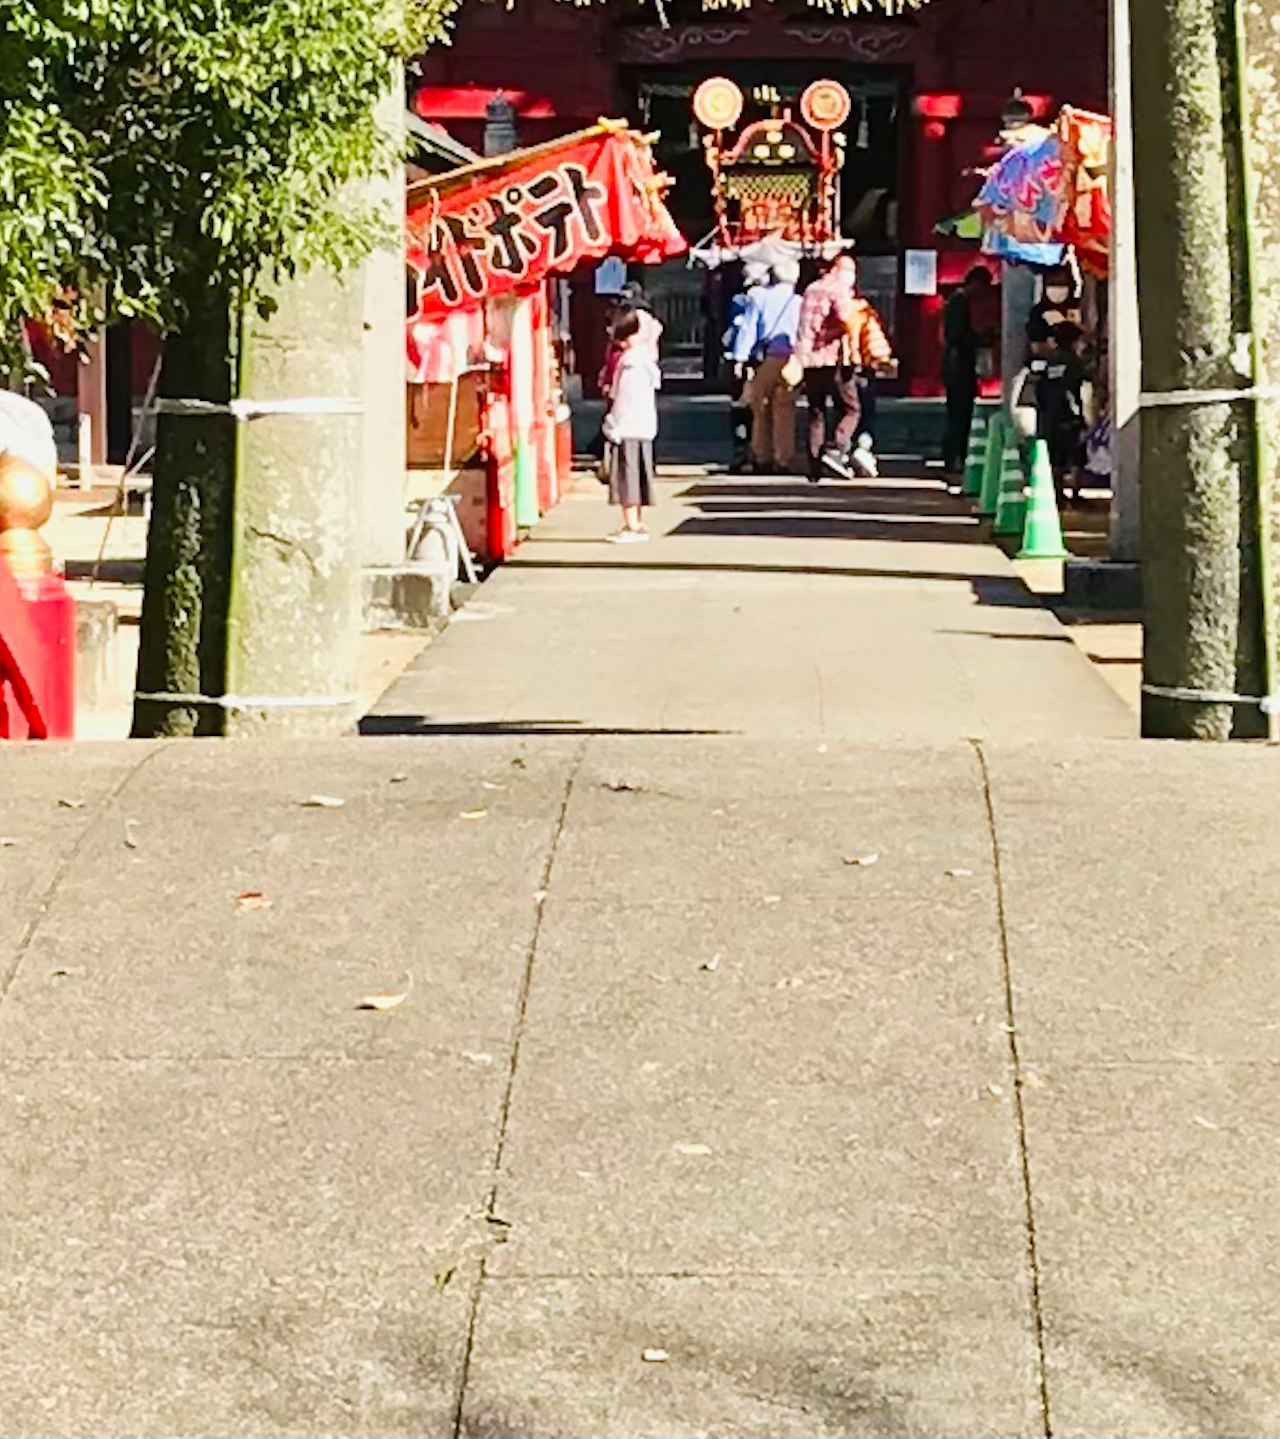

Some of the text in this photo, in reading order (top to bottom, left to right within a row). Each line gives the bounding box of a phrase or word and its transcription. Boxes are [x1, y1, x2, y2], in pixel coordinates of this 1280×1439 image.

[407, 163, 605, 316] イドポテト
